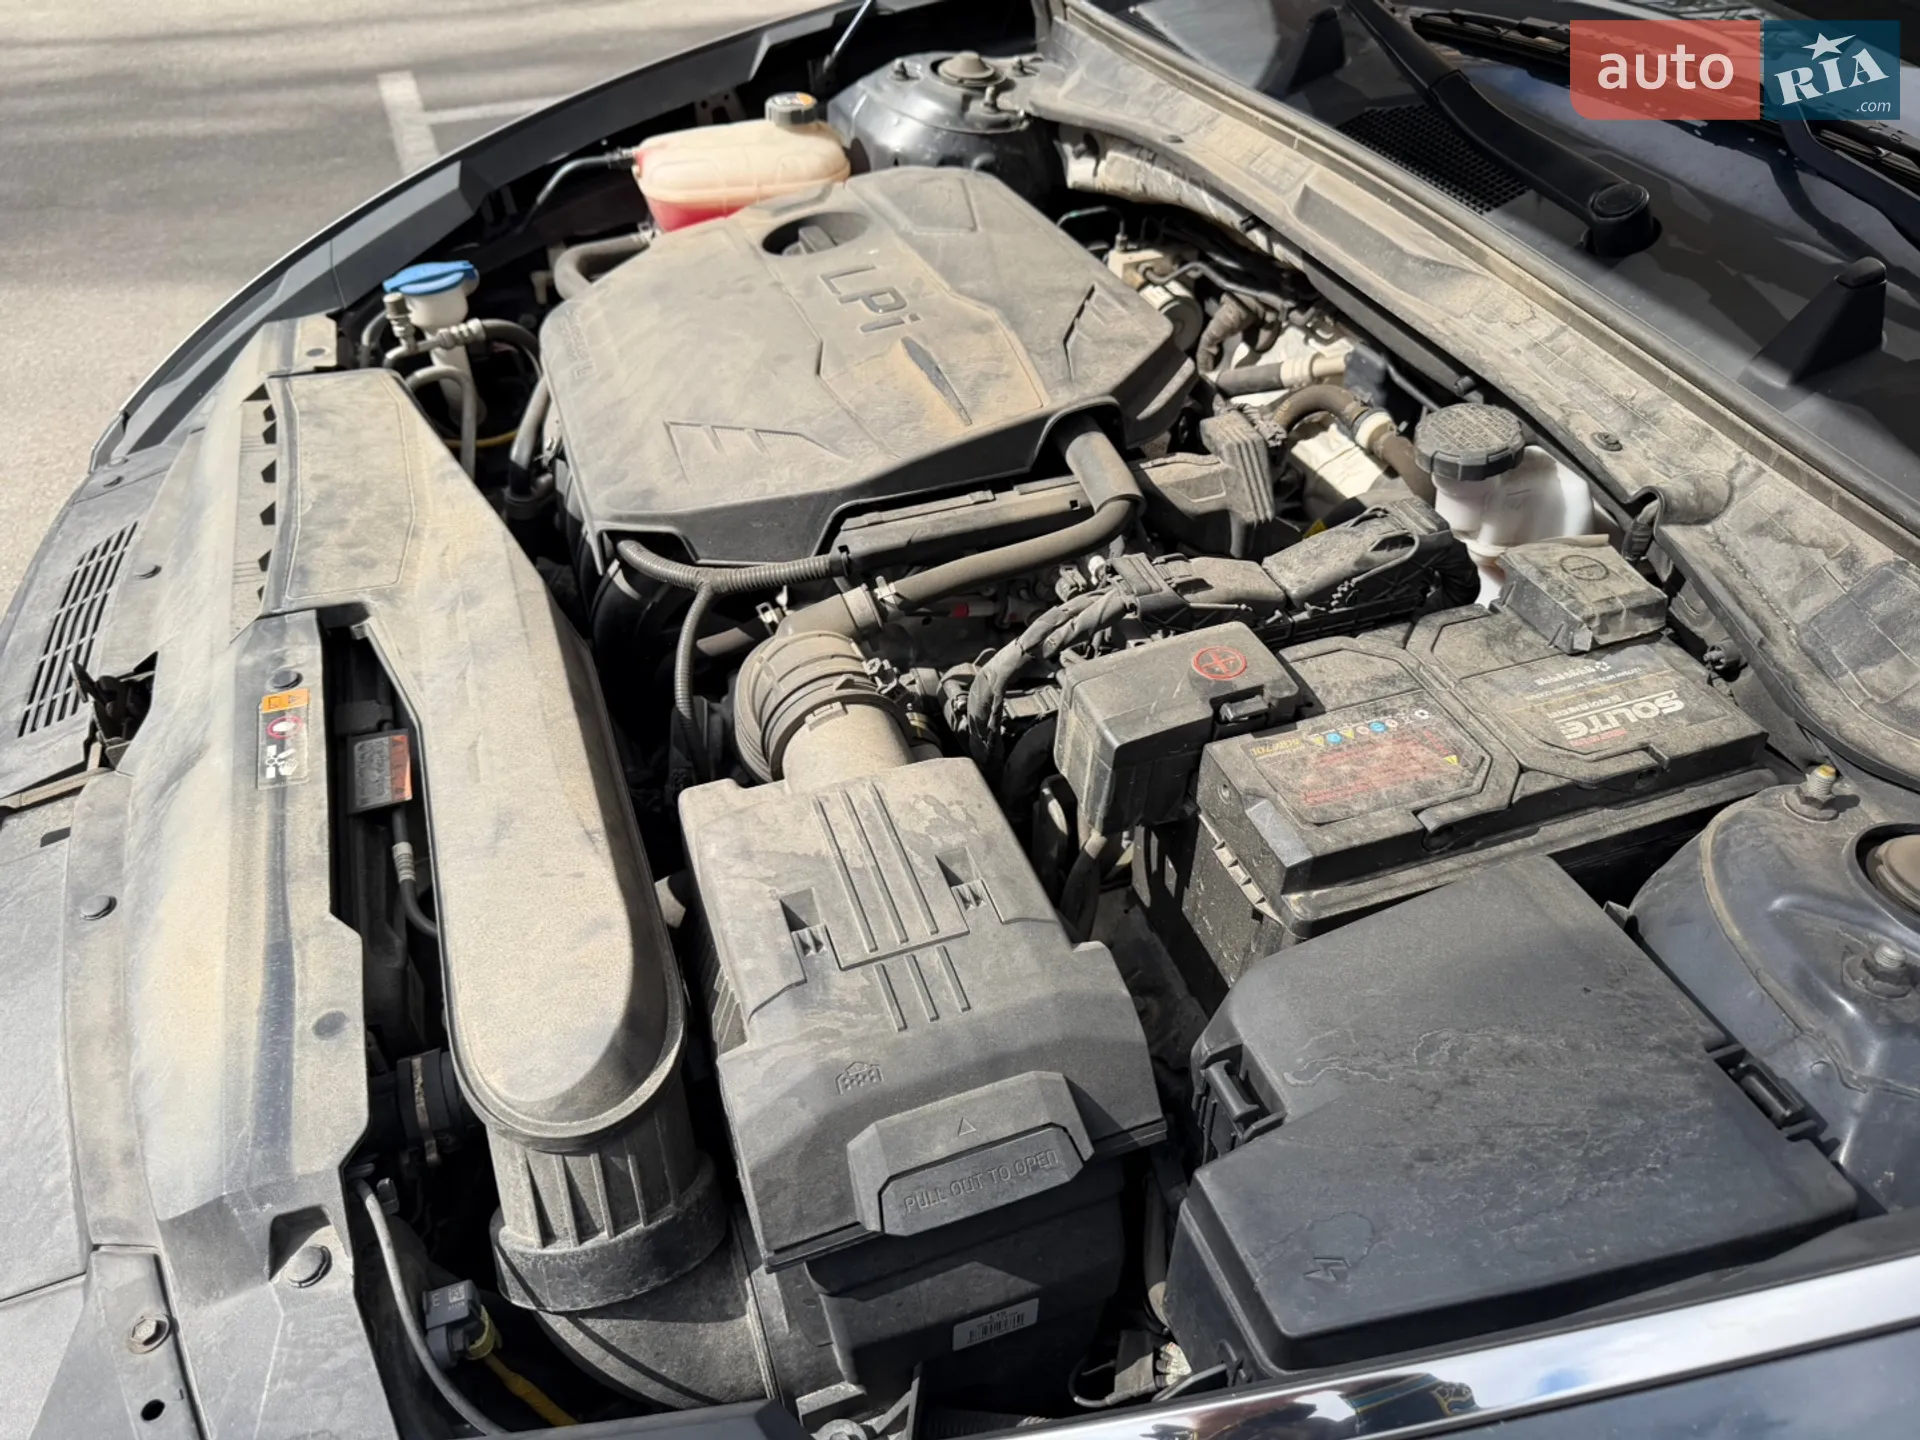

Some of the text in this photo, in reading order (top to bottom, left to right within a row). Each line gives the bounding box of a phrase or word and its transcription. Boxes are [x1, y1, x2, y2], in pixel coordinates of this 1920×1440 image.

[1560, 693, 1685, 741] SOLITE
[903, 1149, 1059, 1213] PULL OUT TO OPEN
